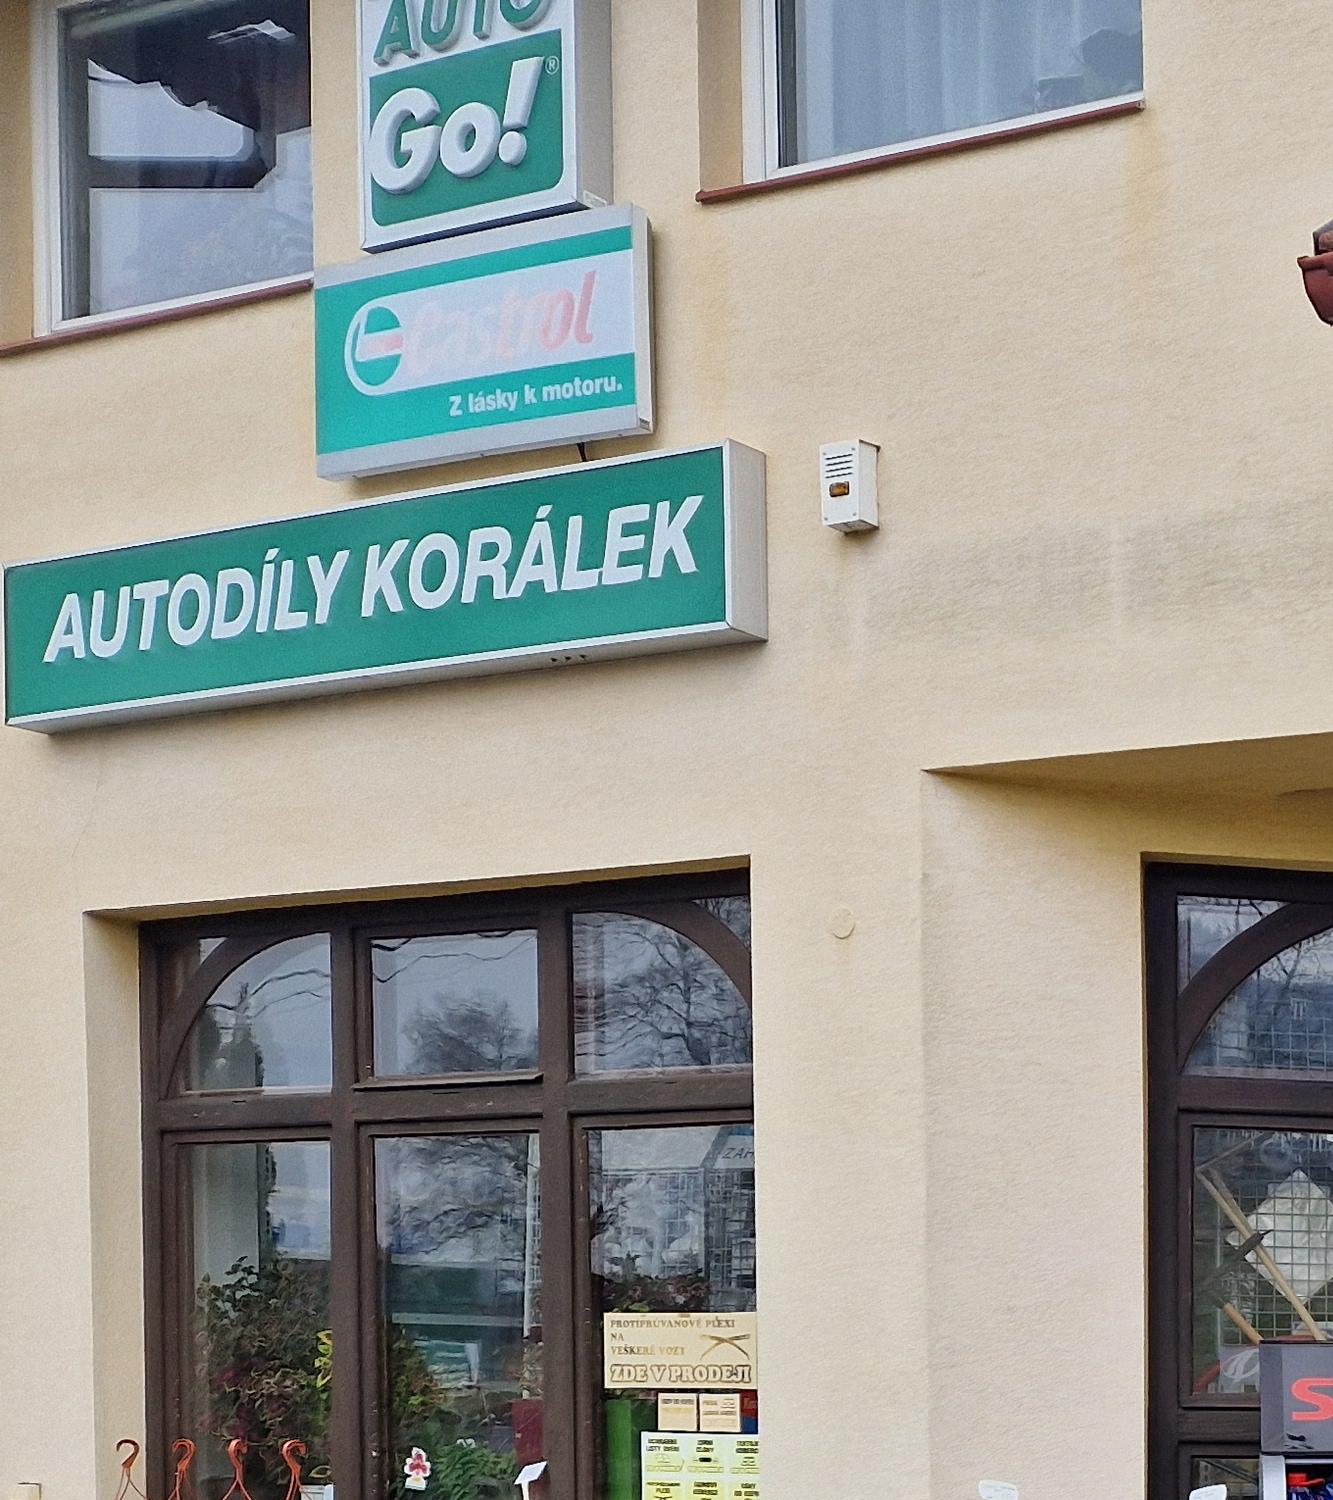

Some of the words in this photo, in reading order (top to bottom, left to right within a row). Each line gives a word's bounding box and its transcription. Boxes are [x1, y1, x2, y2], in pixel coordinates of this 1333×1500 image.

[369, 55, 545, 196] Go!
[401, 268, 598, 372] Castrol
[449, 394, 463, 416] Z
[468, 386, 519, 415] lásky
[524, 384, 538, 405] k
[542, 374, 623, 402] motoru.
[42, 548, 350, 664] AUTODÍLY
[361, 494, 704, 620] KORÁLEK
[610, 1333, 624, 1342] NA
[610, 1364, 648, 1382] ZDE
[651, 1364, 667, 1382] V
[669, 1364, 751, 1383] PRODEJI
